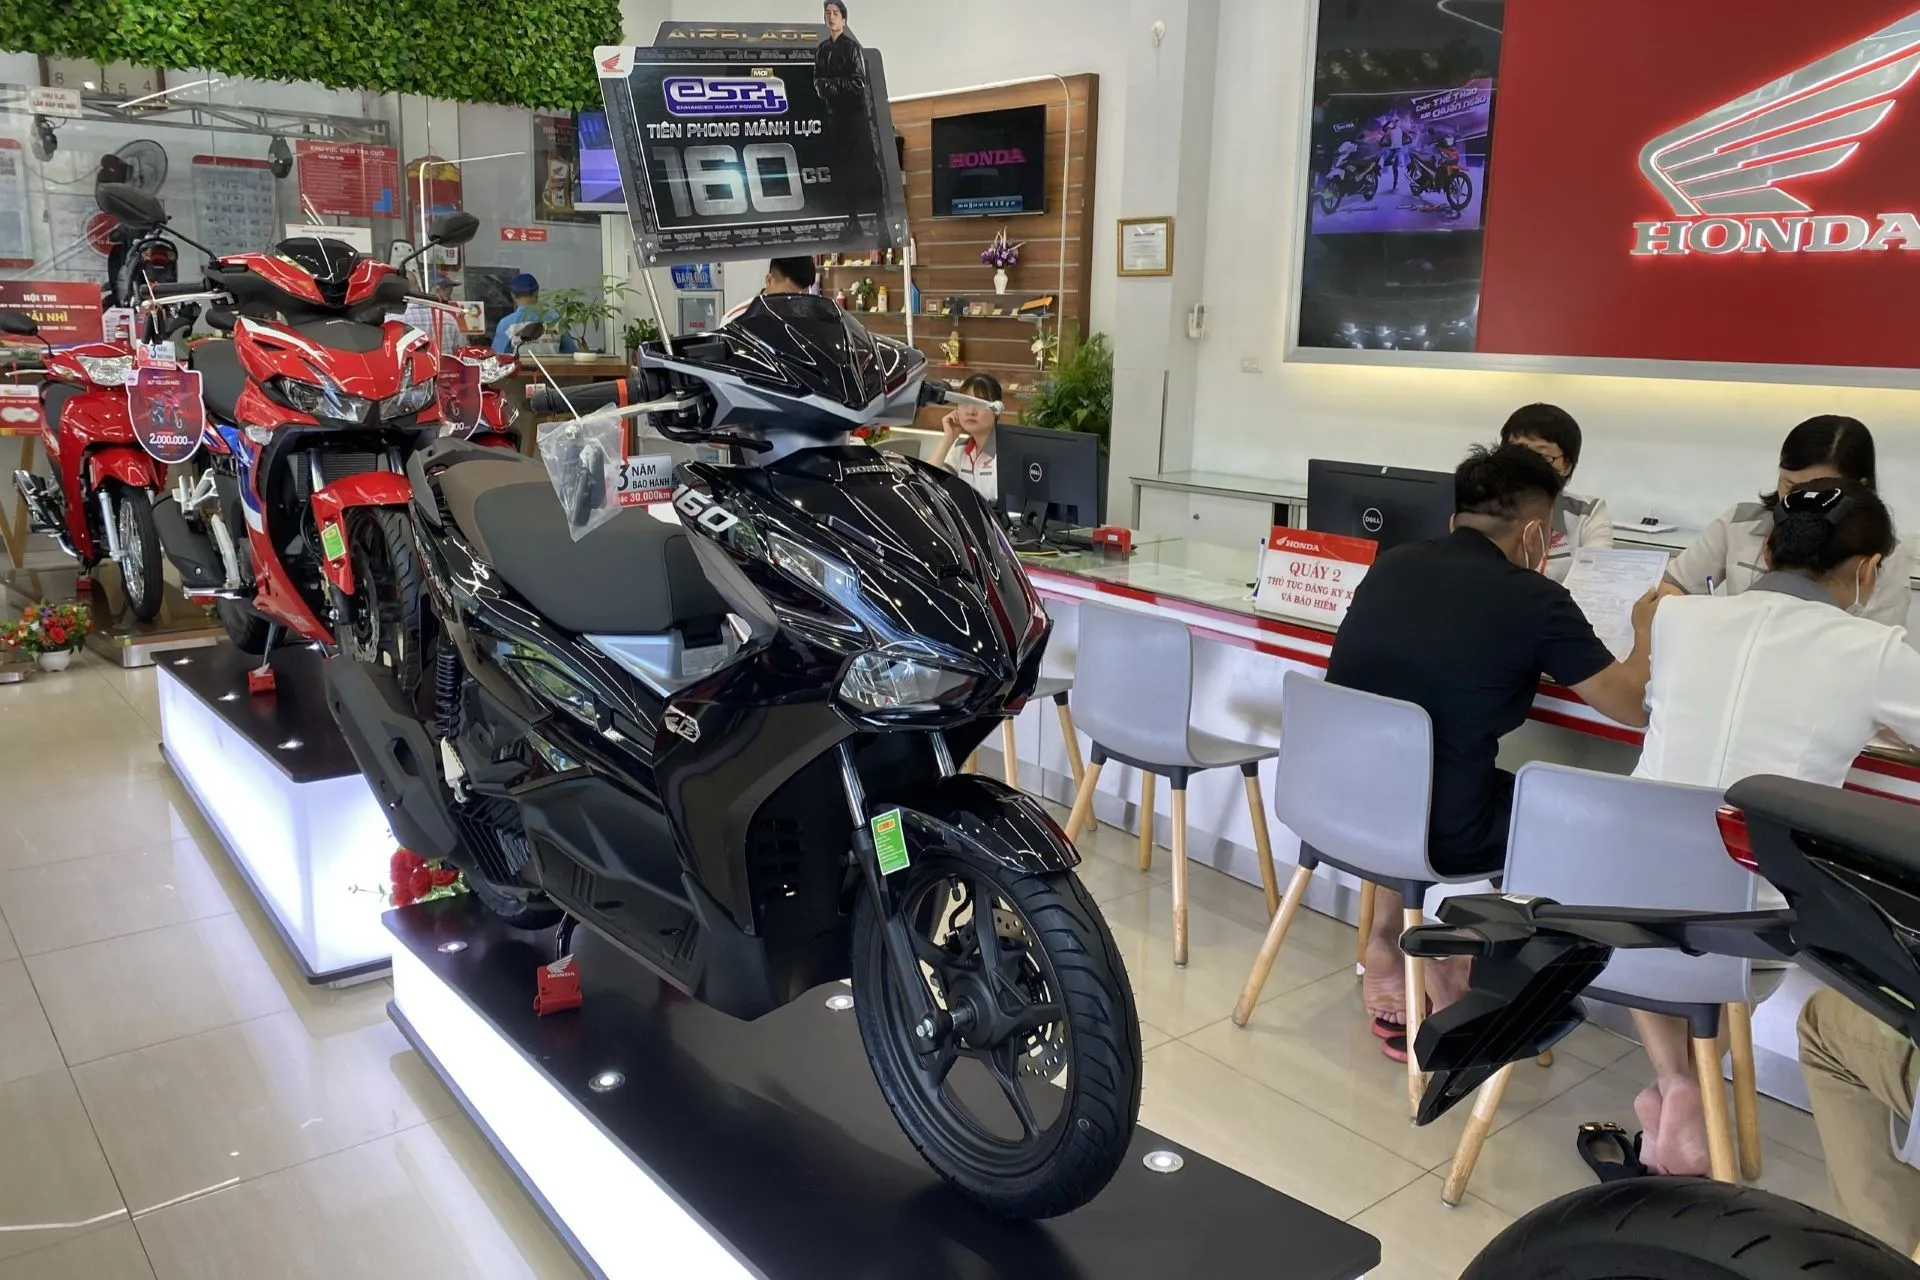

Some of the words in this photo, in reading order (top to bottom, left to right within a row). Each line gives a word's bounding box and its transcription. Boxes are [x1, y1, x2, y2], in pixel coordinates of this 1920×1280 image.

[647, 120, 682, 139] TIÊN
[687, 122, 740, 138] PHONG
[745, 118, 790, 136] MÃNH
[794, 119, 822, 137] LỰC
[949, 148, 1025, 168] HONDA
[652, 142, 805, 218] 160
[1630, 213, 1920, 255] HONDA
[617, 464, 630, 492] 3
[631, 463, 657, 477] NĂM
[1364, 516, 1381, 524] DELL
[1285, 540, 1321, 552] HONDA
[1331, 568, 1342, 583] 2
